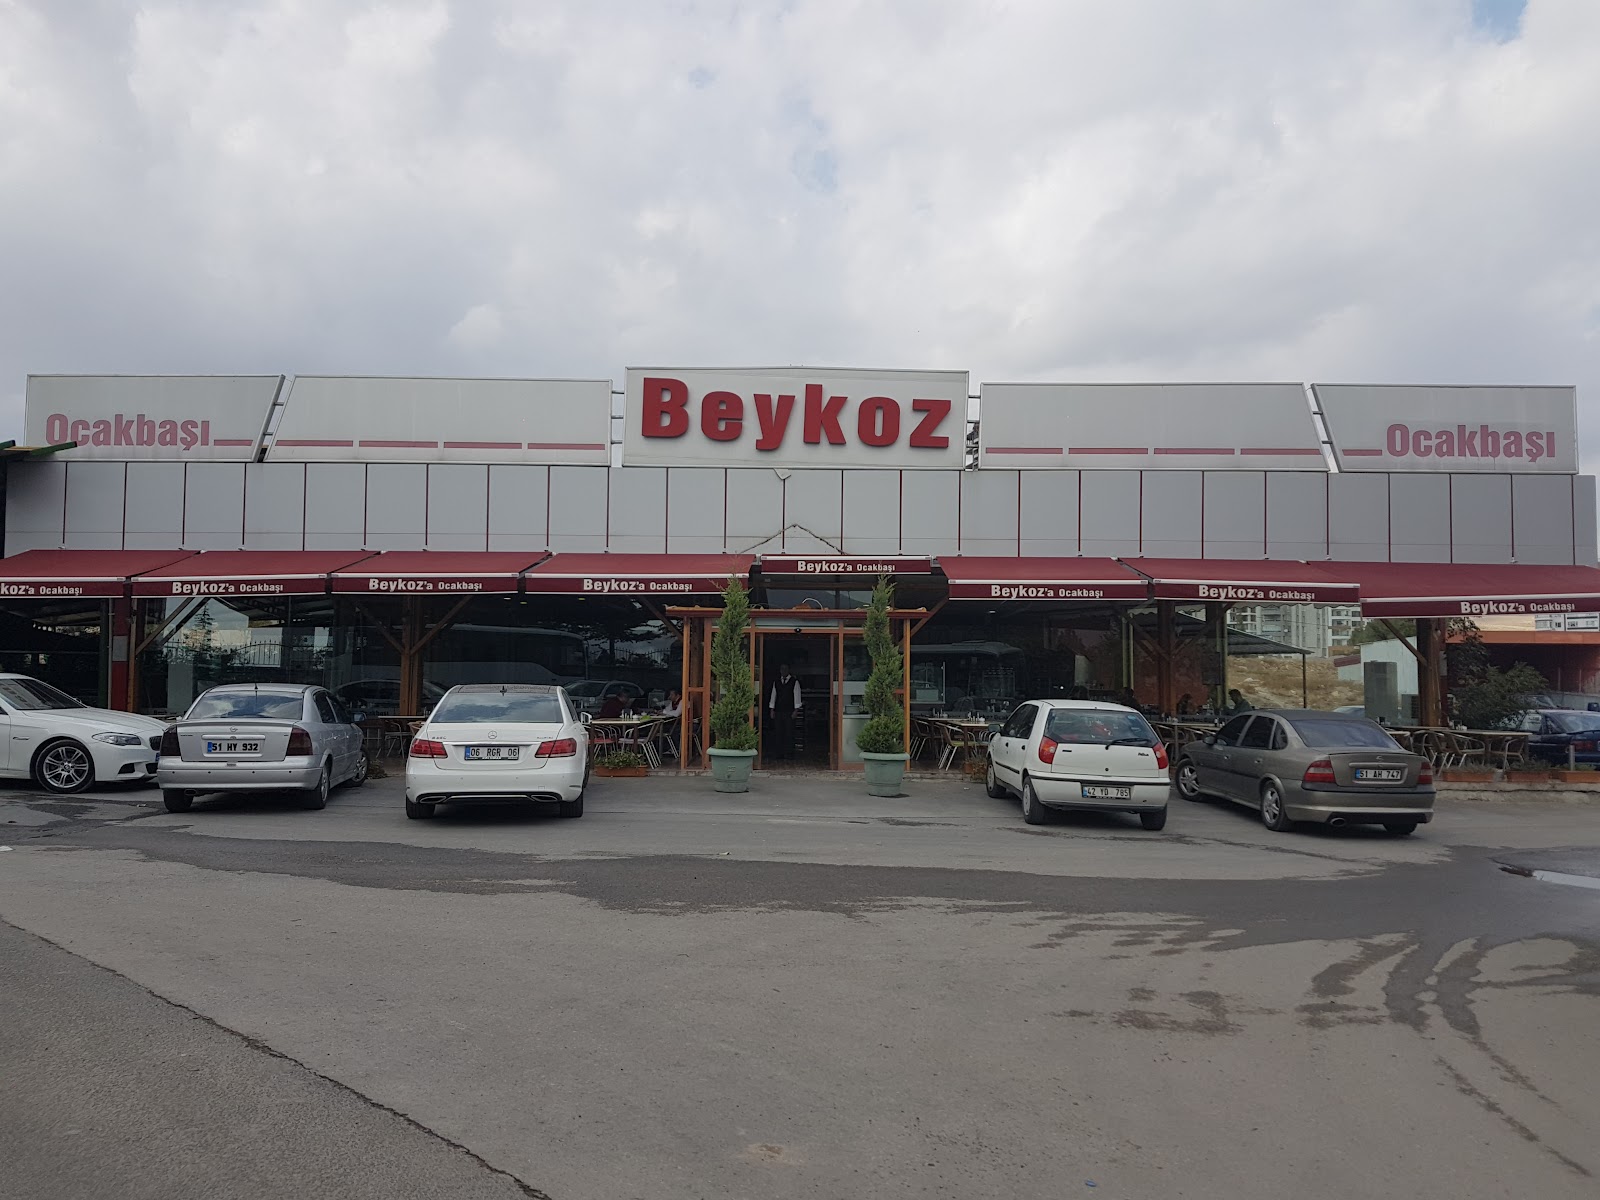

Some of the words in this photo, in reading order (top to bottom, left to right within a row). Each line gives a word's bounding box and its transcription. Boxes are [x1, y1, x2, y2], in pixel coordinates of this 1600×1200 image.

[641, 377, 952, 450] Beykoz
[46, 414, 211, 450] Ocakbaşı
[1387, 424, 1556, 461] Ocakbaşı
[797, 560, 853, 573] Beykoz'a
[856, 562, 896, 573] Ocakbaşı
[40, 585, 83, 596] Ocakbaşı
[172, 581, 235, 596] Beykoz'a
[239, 582, 284, 594] Ocakbaşı
[368, 578, 434, 592] Beykoz'a
[438, 581, 482, 592] Ocakbaşı
[583, 578, 645, 592] Beykoz'a
[649, 581, 693, 592] Ocakbaşı
[991, 584, 1054, 599] Beykoz'a
[1058, 587, 1104, 599] Ocakbaşı
[1198, 584, 1265, 600] Beykoz'a
[1269, 590, 1315, 602] Ocakbaşı
[1460, 601, 1526, 615] Beykoz'a
[1529, 602, 1576, 613] Ocakbaşı
[212, 742, 222, 752] 51
[226, 742, 238, 752] HY
[242, 742, 259, 752] 932
[470, 747, 481, 757] 06
[486, 747, 502, 757] RGR
[507, 747, 518, 757] 06
[1360, 769, 1368, 778] 51
[1372, 770, 1383, 778] AH
[1386, 770, 1400, 779] 747
[1088, 787, 1096, 796] 42
[1115, 788, 1129, 797] 785
